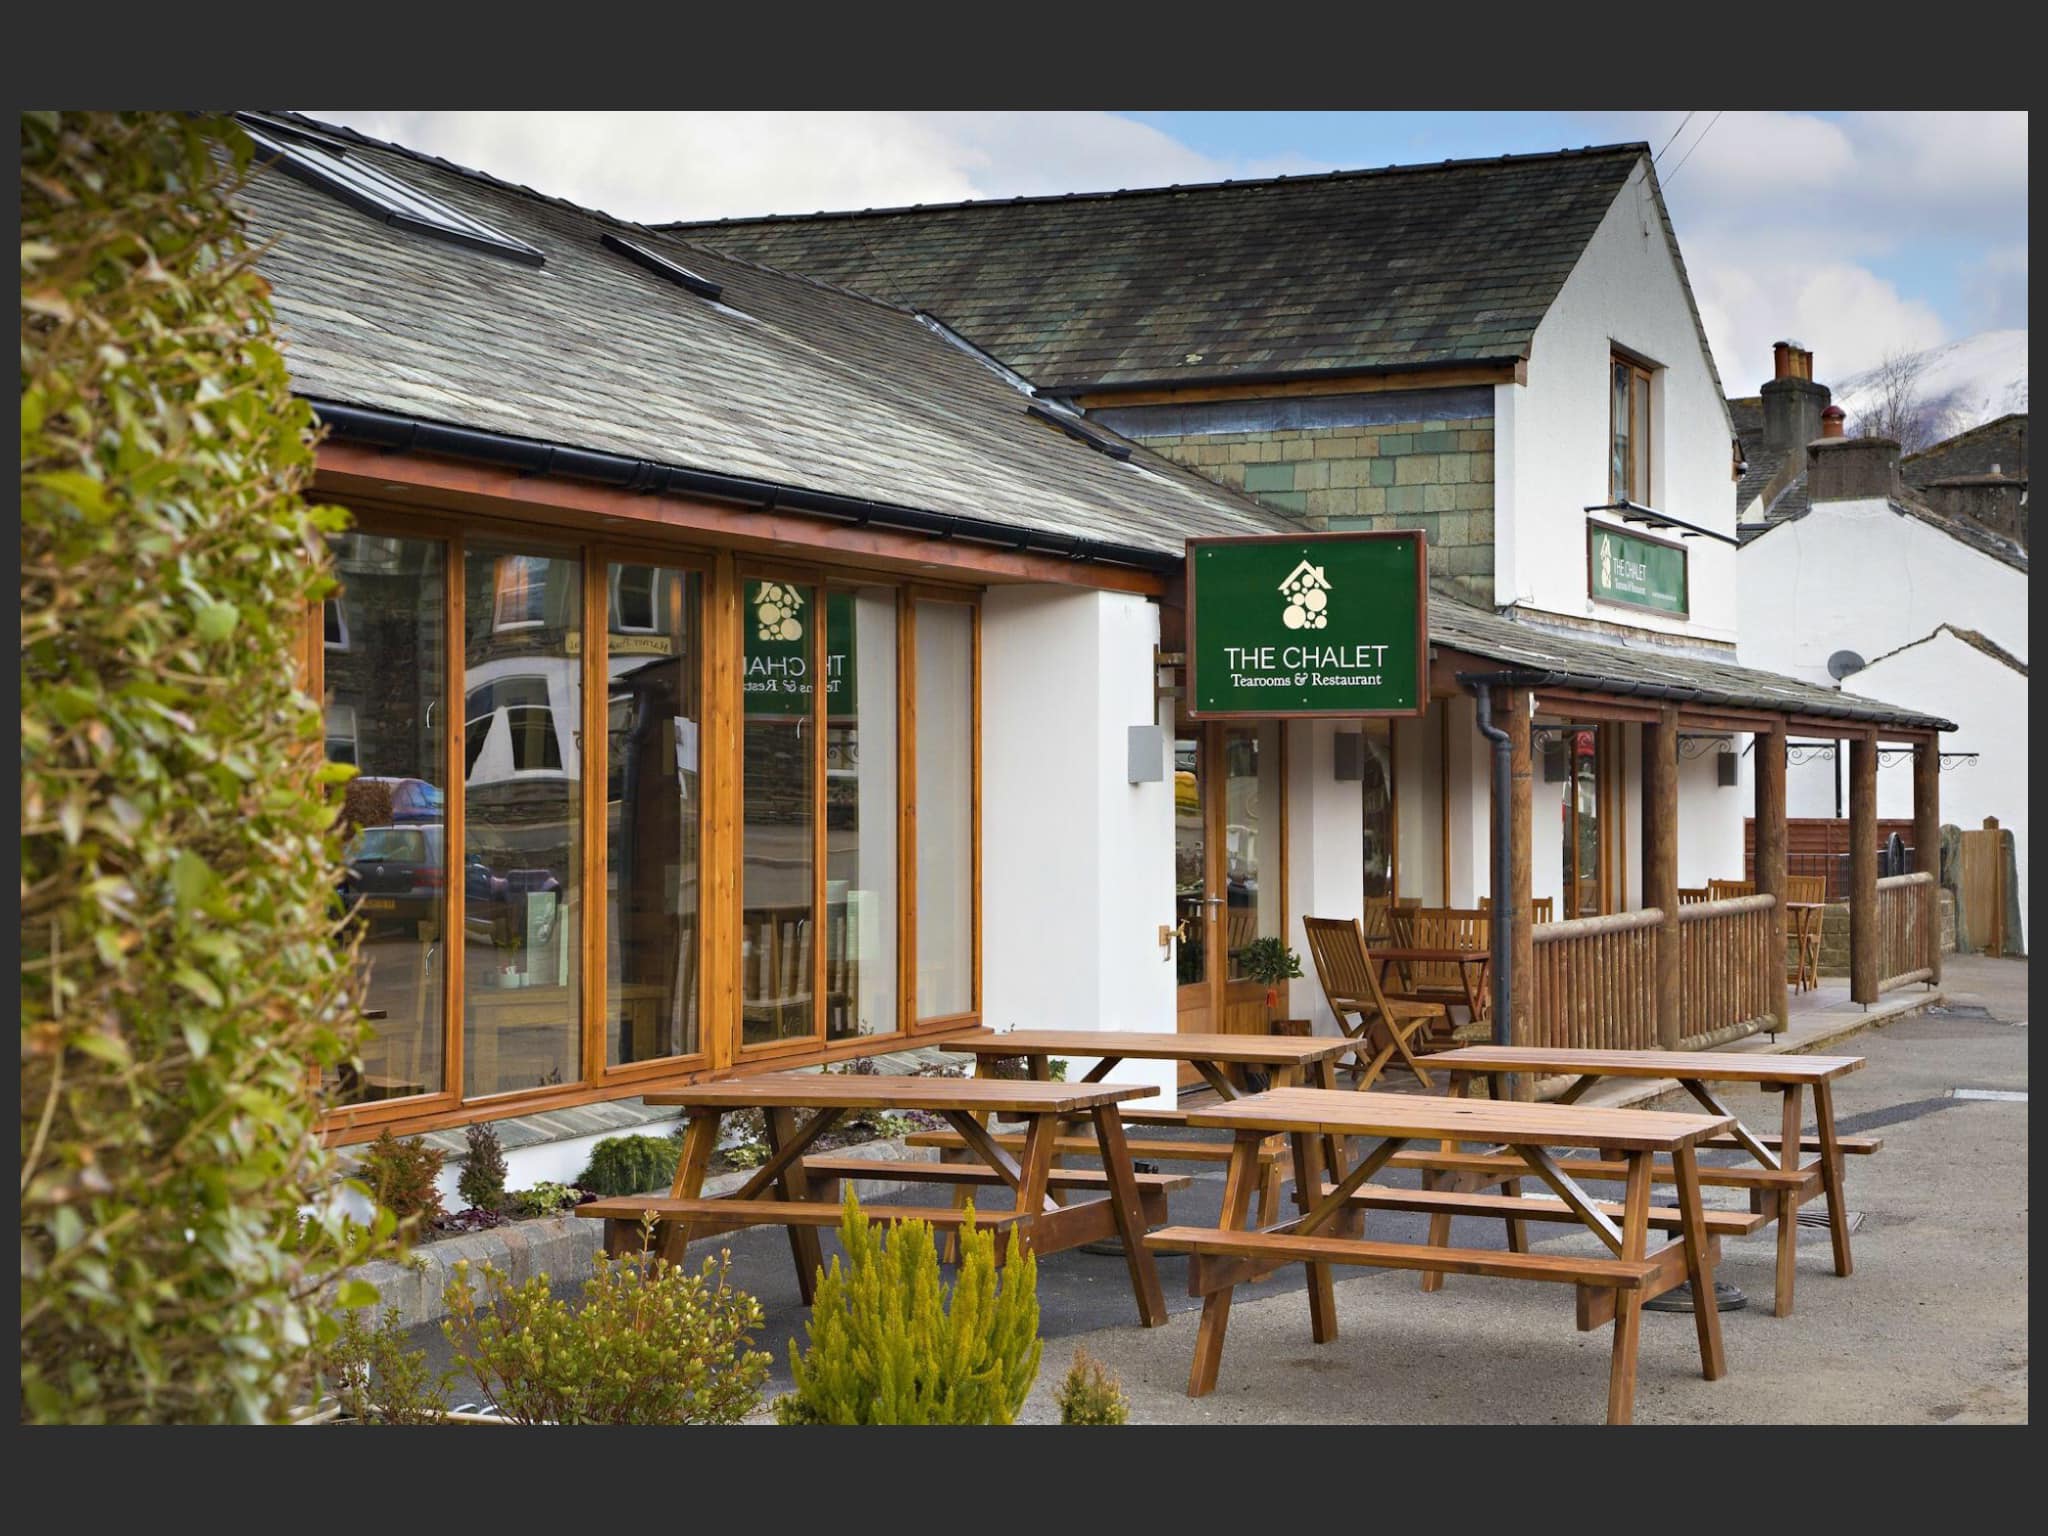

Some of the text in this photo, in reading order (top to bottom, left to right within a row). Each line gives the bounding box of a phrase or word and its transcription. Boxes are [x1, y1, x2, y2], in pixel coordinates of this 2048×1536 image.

[1224, 645, 1389, 669] THE CHALET
[1231, 672, 1382, 687] Tearooms & Restaurant
